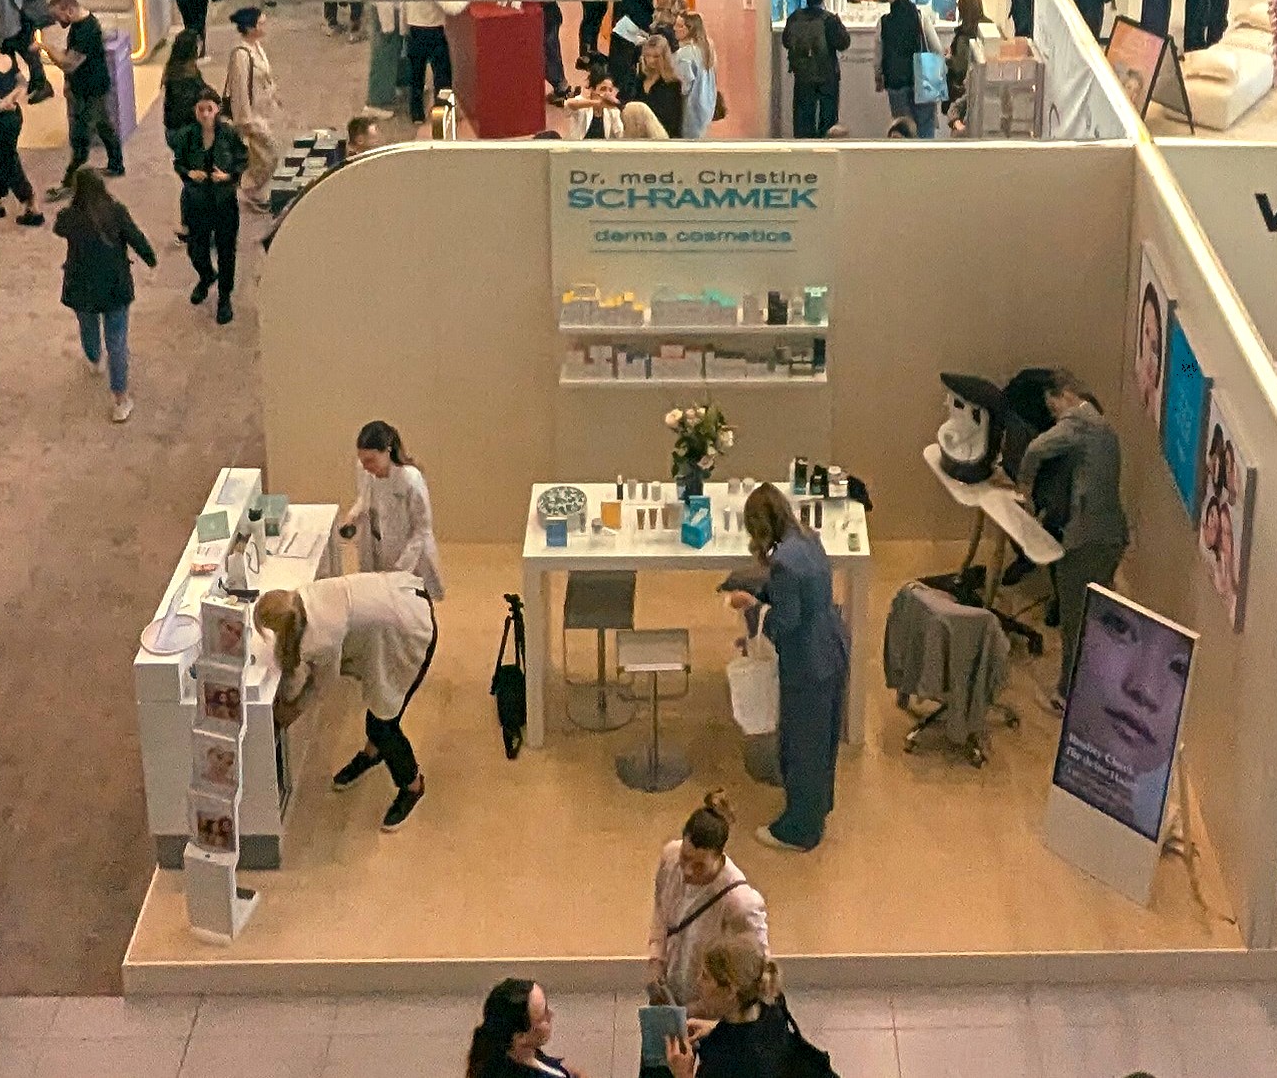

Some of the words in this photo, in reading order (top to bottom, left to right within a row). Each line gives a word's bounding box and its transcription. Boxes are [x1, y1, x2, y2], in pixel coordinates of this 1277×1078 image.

[570, 171, 605, 184] Dr.
[620, 171, 683, 184] med.
[698, 171, 818, 184] Christine
[568, 187, 818, 209] SCHRAMMEK
